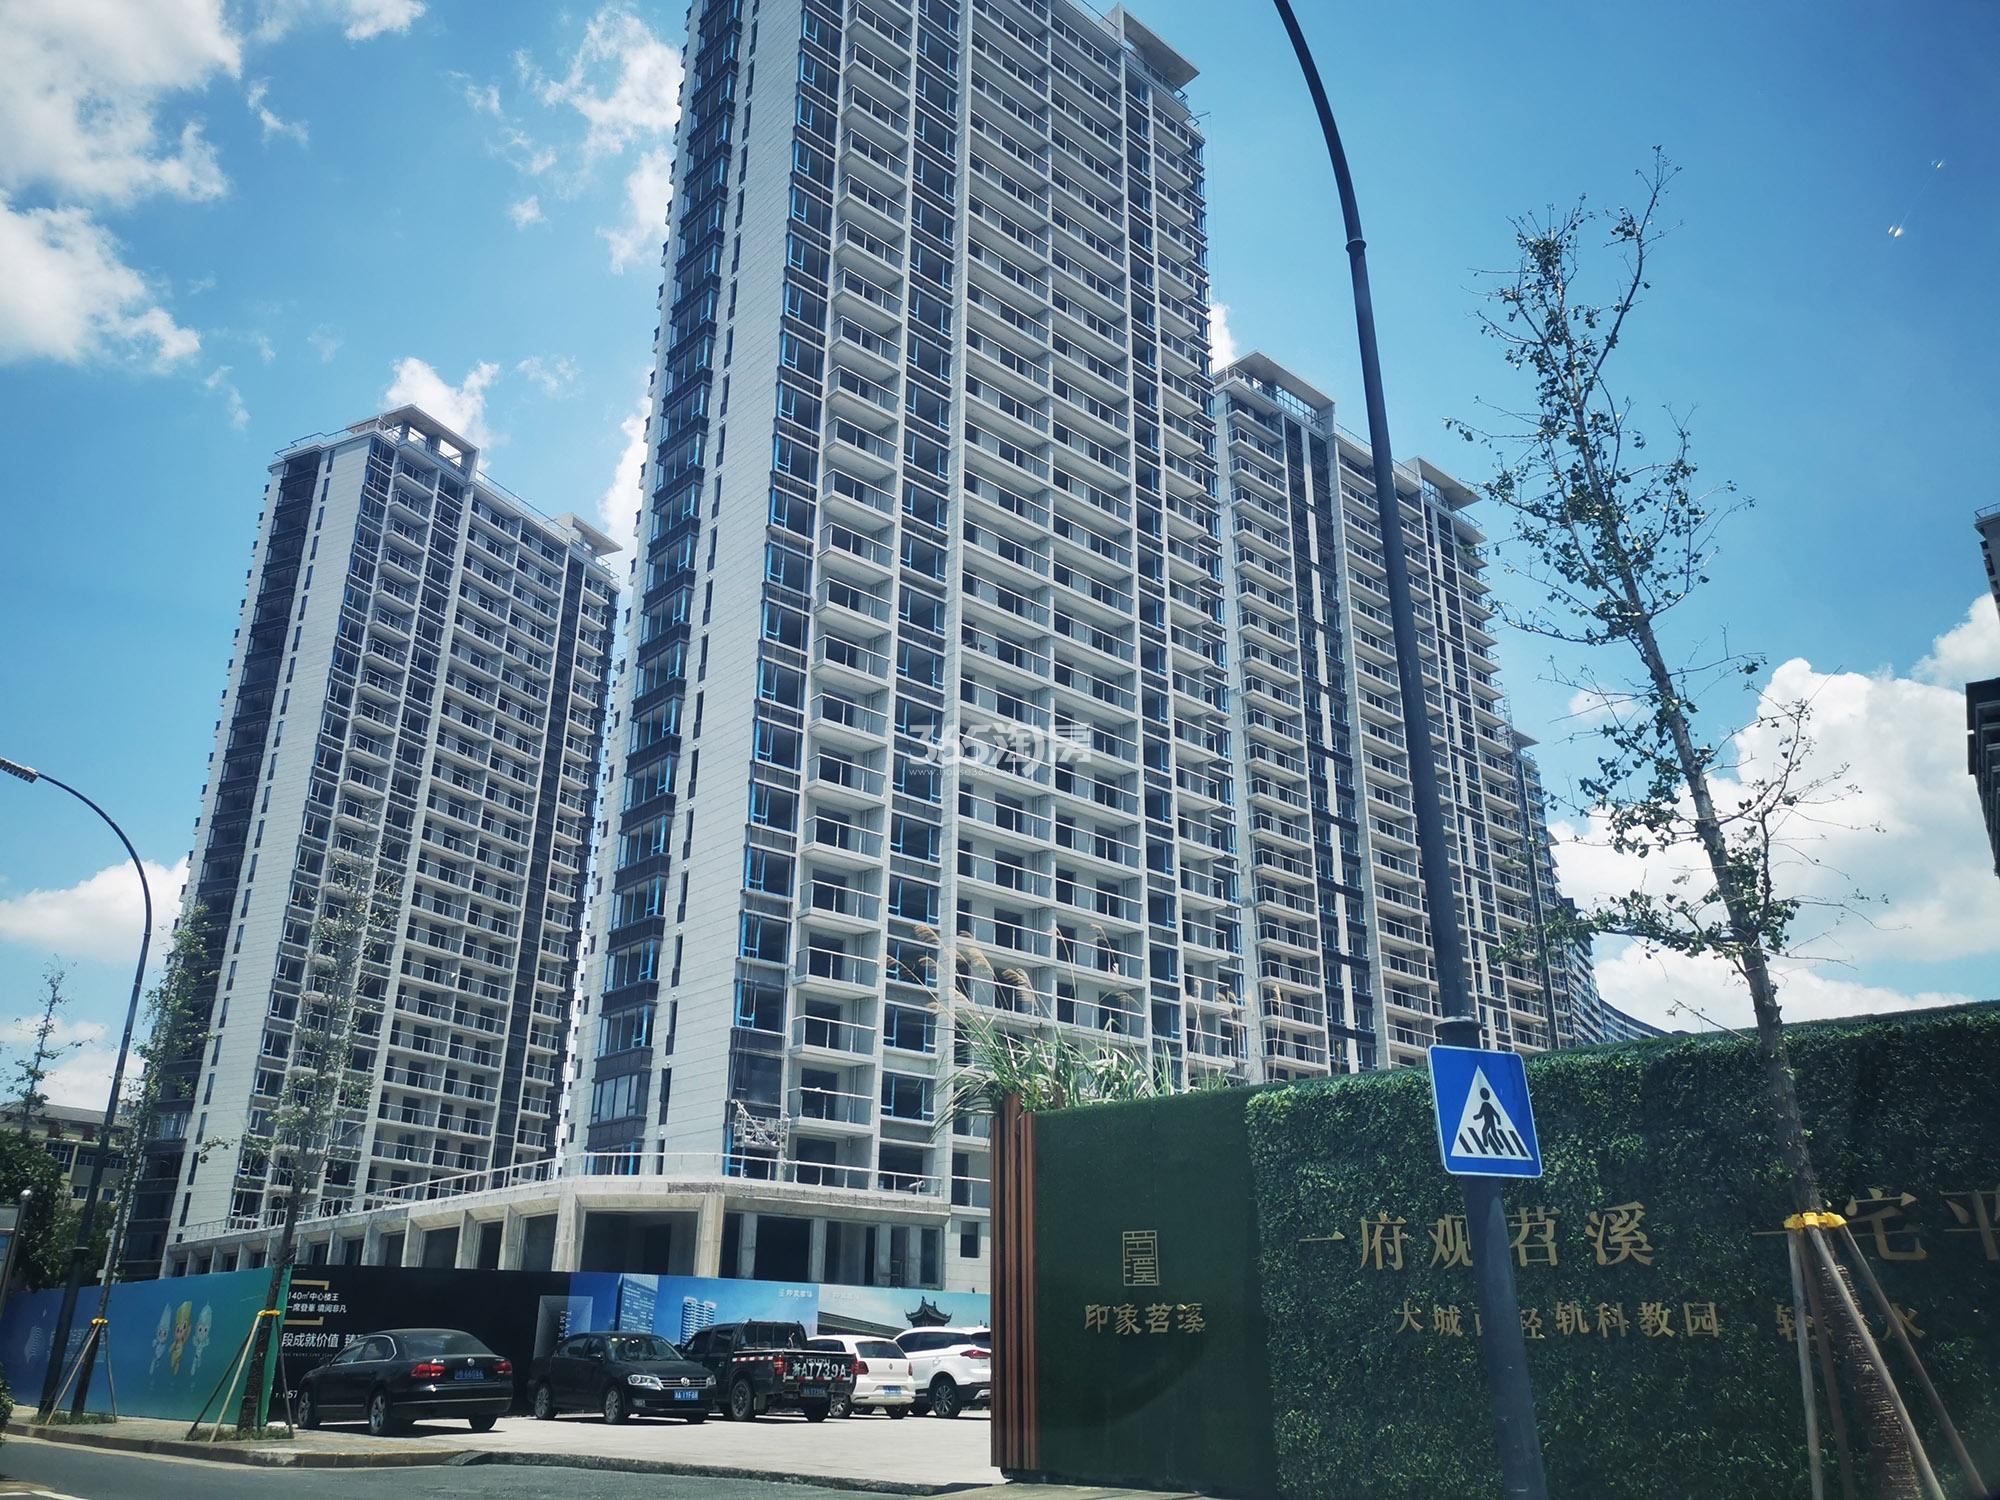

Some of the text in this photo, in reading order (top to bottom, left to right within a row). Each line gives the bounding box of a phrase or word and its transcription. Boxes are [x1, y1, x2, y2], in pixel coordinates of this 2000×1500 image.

[1084, 1302, 1206, 1335] 印象苕溪
[1393, 1298, 1720, 1340] 大城轻轨科教园
